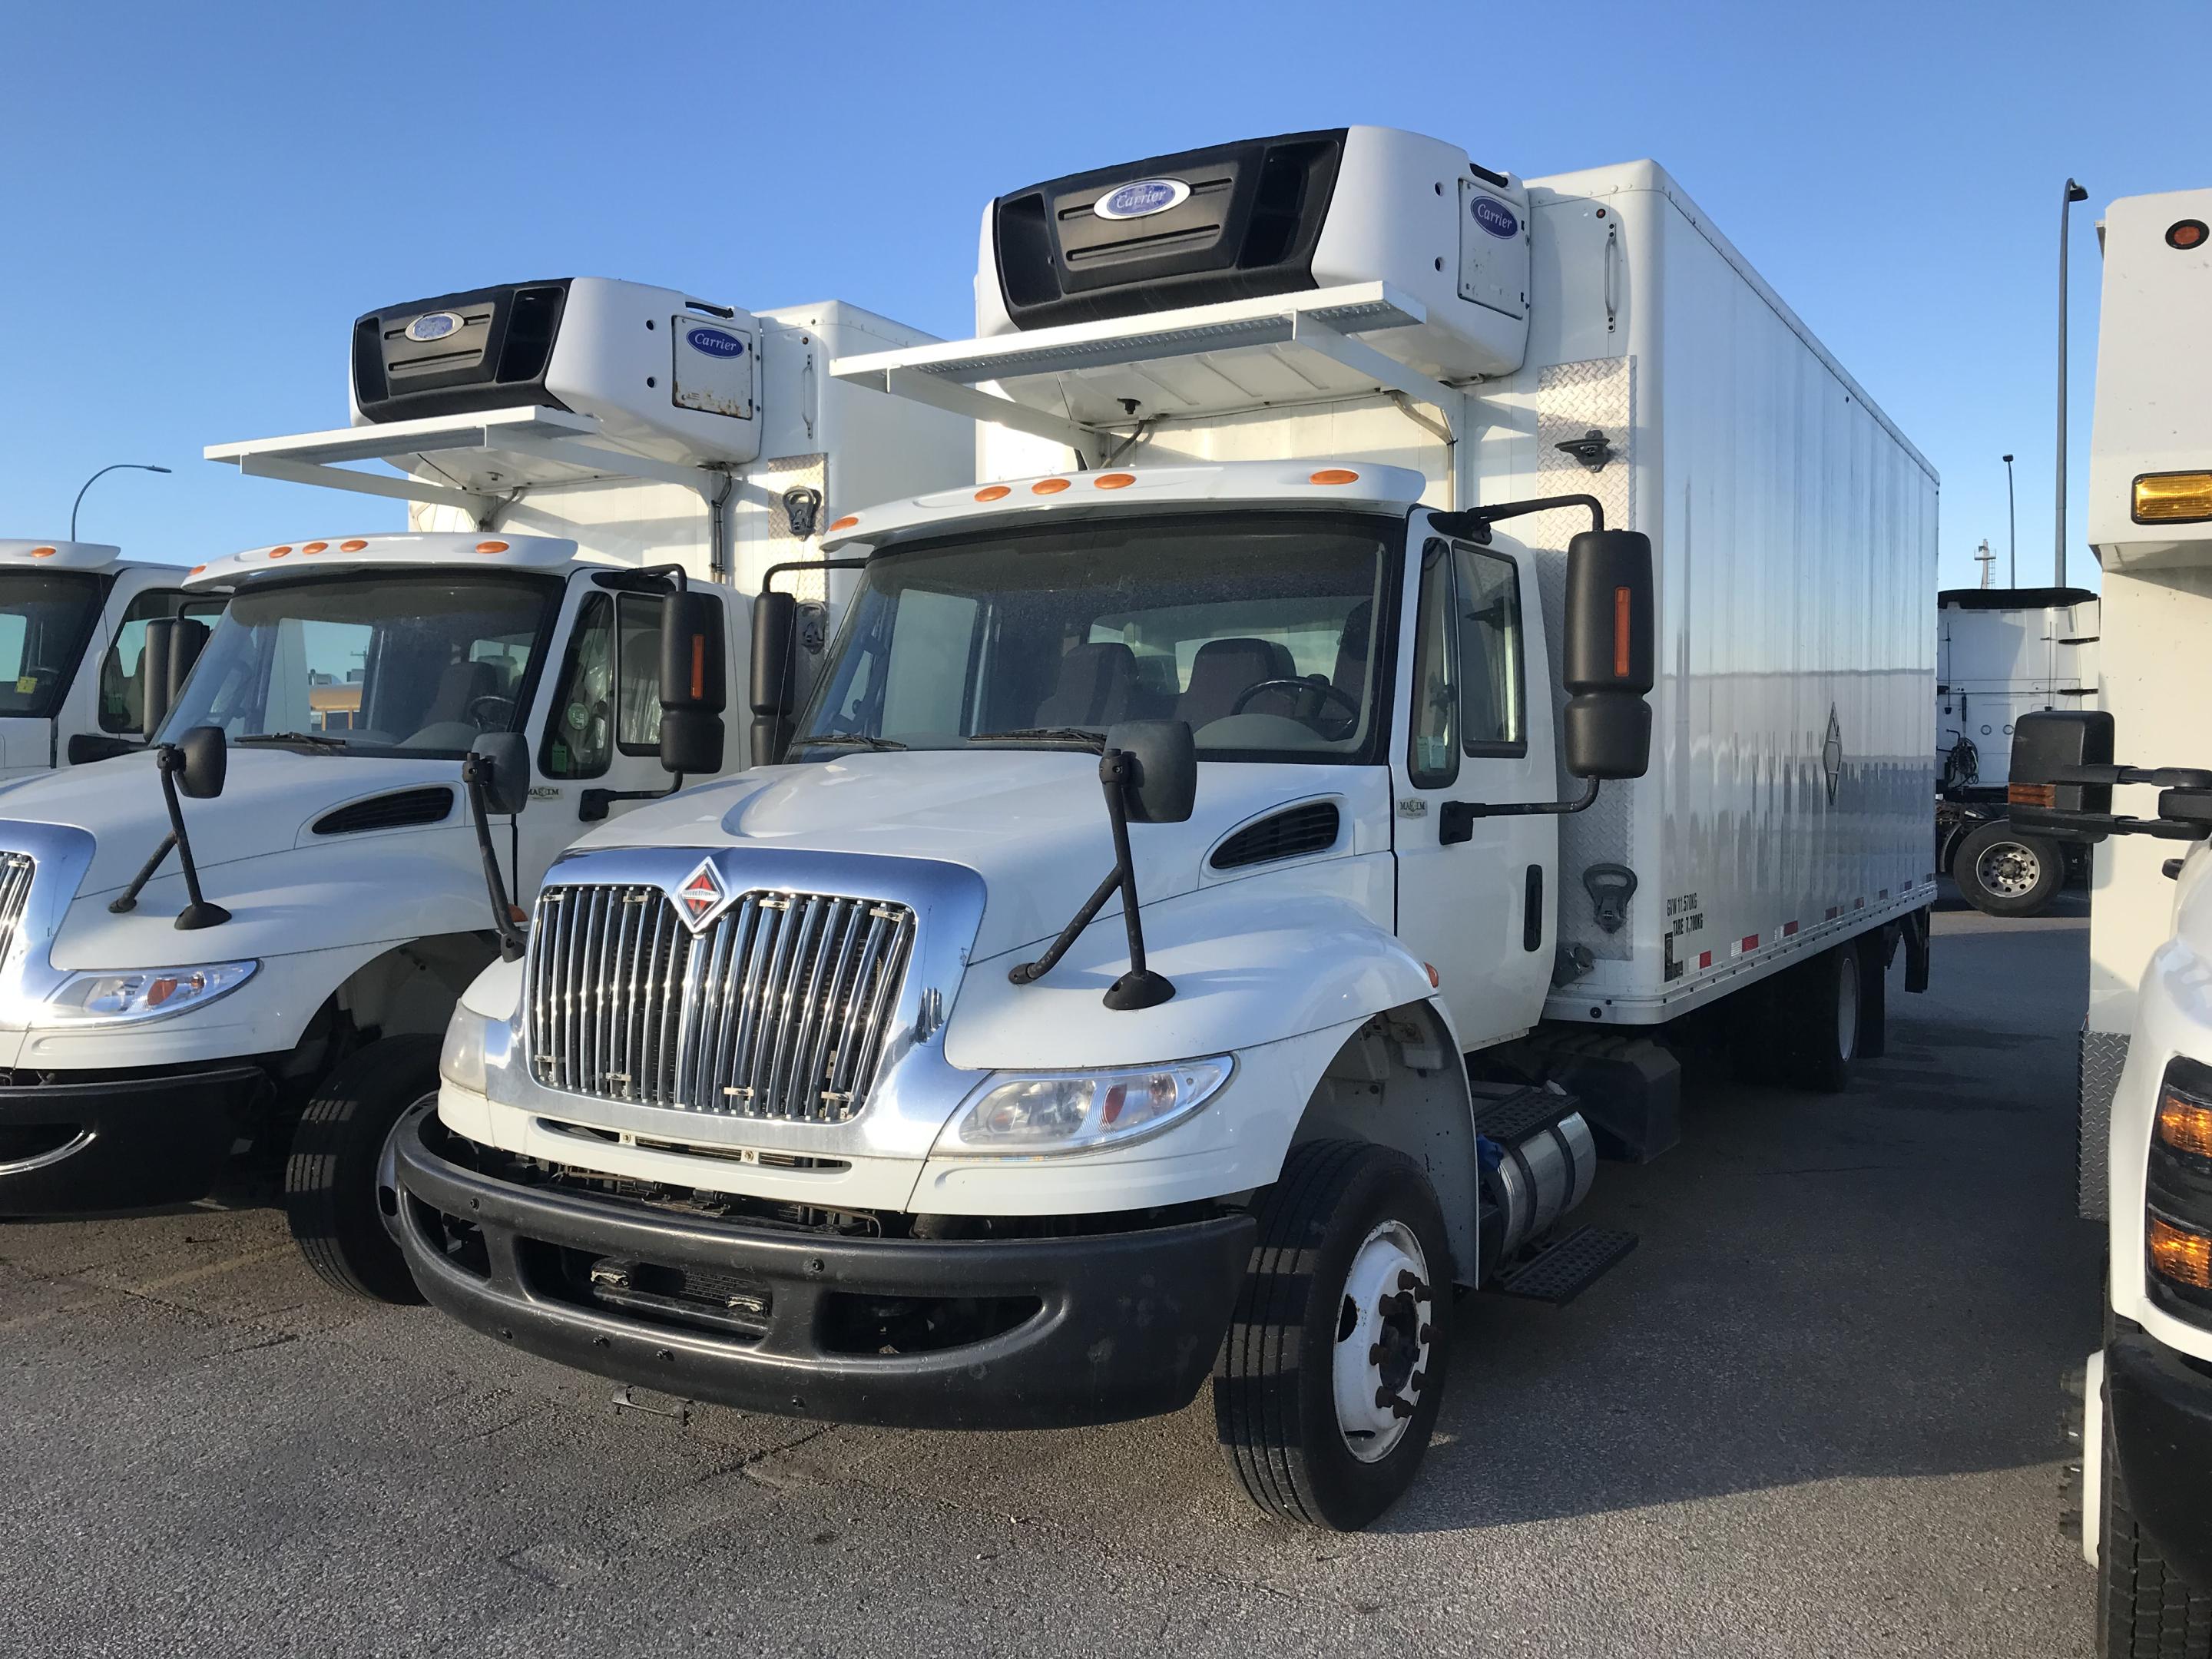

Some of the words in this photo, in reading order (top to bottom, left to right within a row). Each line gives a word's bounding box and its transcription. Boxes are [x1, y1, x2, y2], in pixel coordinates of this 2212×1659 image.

[1116, 190, 1166, 208] Carrier
[1478, 204, 1512, 229] Carrier
[694, 333, 737, 351] Carrier
[1667, 897, 1677, 916] GVW
[1673, 918, 1684, 936] TARE
